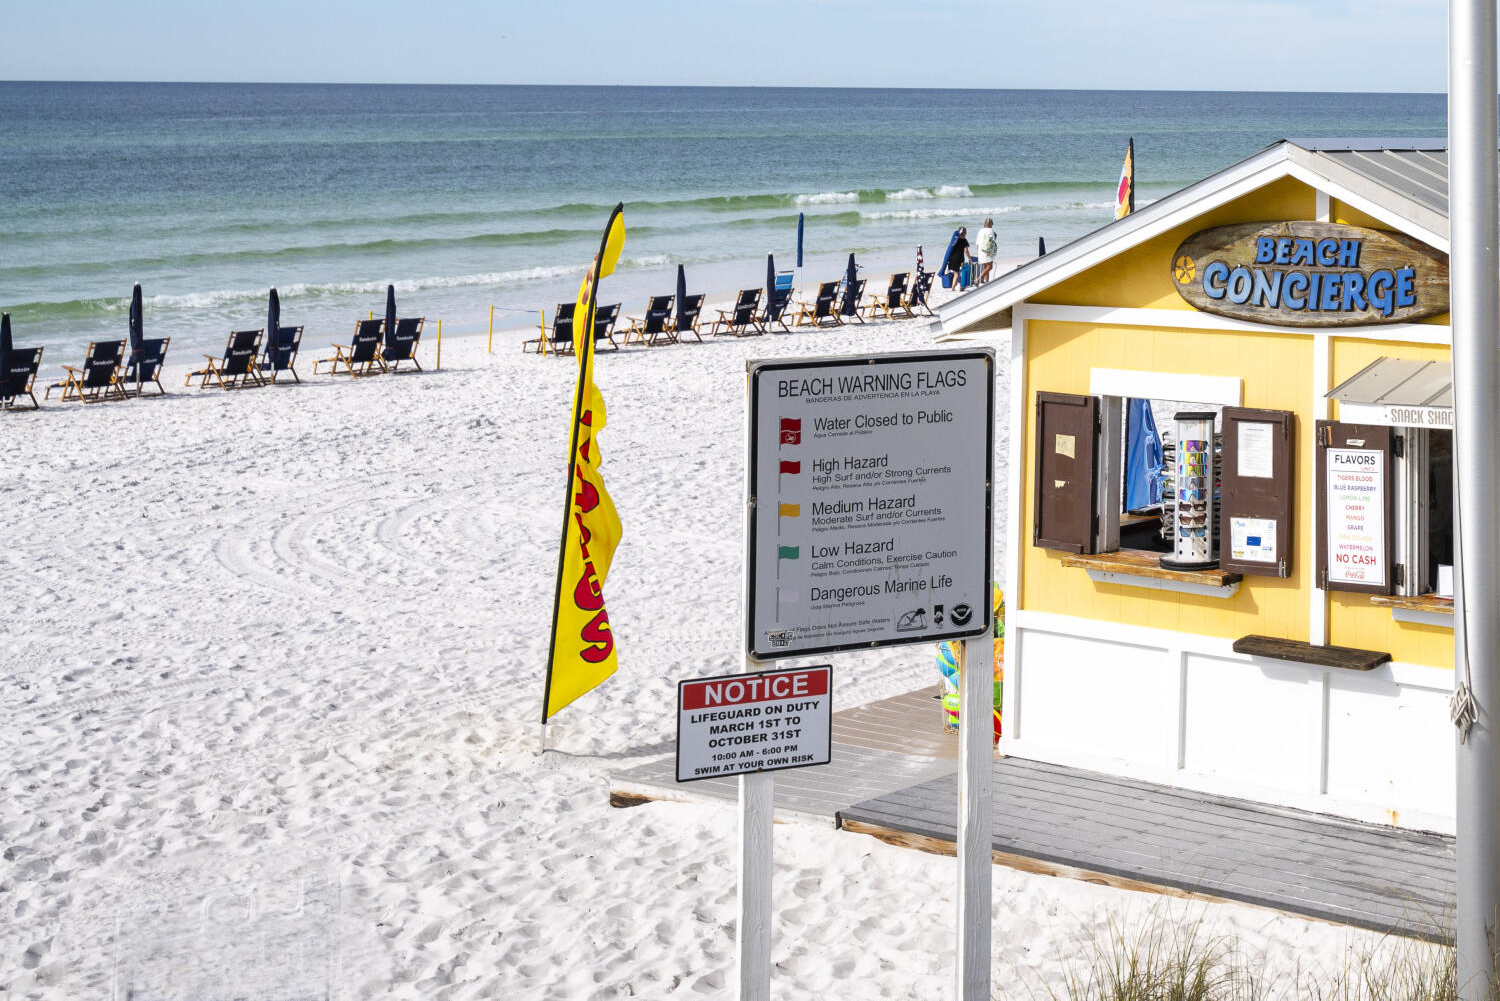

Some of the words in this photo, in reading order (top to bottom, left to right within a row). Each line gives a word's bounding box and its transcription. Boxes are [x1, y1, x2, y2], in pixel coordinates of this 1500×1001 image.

[1255, 236, 1362, 267] BEACH
[1202, 262, 1416, 317] CONCIERGE
[778, 377, 832, 397] BEACH
[838, 373, 912, 394] WARNING
[917, 370, 967, 389] FLAGS
[806, 395, 842, 404] BANDERAS
[854, 391, 899, 400] ADVERTENCIA
[814, 417, 851, 432] Water
[855, 413, 898, 429] Closed
[902, 414, 913, 426] to
[917, 409, 953, 424] Public
[1391, 408, 1424, 424] SNACK
[1428, 410, 1453, 425] SHAC
[812, 458, 840, 475] High
[844, 454, 888, 470] Hazard
[1335, 454, 1376, 465] FLAVORS
[812, 475, 832, 485] High
[834, 472, 853, 483] Surf
[855, 470, 882, 481] and/or
[885, 468, 913, 479] Strong
[915, 465, 952, 476] Currents
[812, 499, 864, 516] Medium
[868, 494, 916, 511] Hazard
[1345, 504, 1365, 512] CHERRY
[812, 515, 853, 526] Moderate
[856, 512, 874, 523] Surf
[876, 510, 903, 521] and/or
[905, 507, 942, 518] Currents
[1346, 514, 1365, 522] MANGO
[1347, 524, 1364, 532] GRAPE
[811, 545, 840, 559] Low
[844, 538, 894, 555] Hazard
[1339, 543, 1373, 552] WATERMELON
[811, 561, 834, 571] Calm
[836, 557, 884, 568] Conditions,
[886, 552, 923, 564] Exercise
[925, 550, 958, 560] Caution
[1336, 553, 1349, 564] NO
[1352, 554, 1376, 565] CASH
[811, 583, 881, 602] Dangerous
[885, 579, 927, 594] Marine
[931, 575, 953, 589] Life
[705, 674, 809, 705] NOTICE
[691, 708, 761, 724] LIFEGUARD
[765, 704, 783, 715] ON
[786, 701, 820, 712] DUTY
[710, 721, 754, 735] MARCH
[759, 718, 781, 729] 1ST
[785, 716, 801, 725] TO
[709, 732, 768, 748] OCTOBER
[771, 729, 801, 741] 31ST
[712, 751, 737, 761] 10:00
[739, 749, 754, 759] AM
[784, 744, 798, 753] PM
[694, 765, 720, 775] SWIM
[723, 763, 735, 772] AT
[738, 760, 764, 770] YOUR
[767, 757, 789, 766] OWN
[792, 754, 814, 763] RISK
